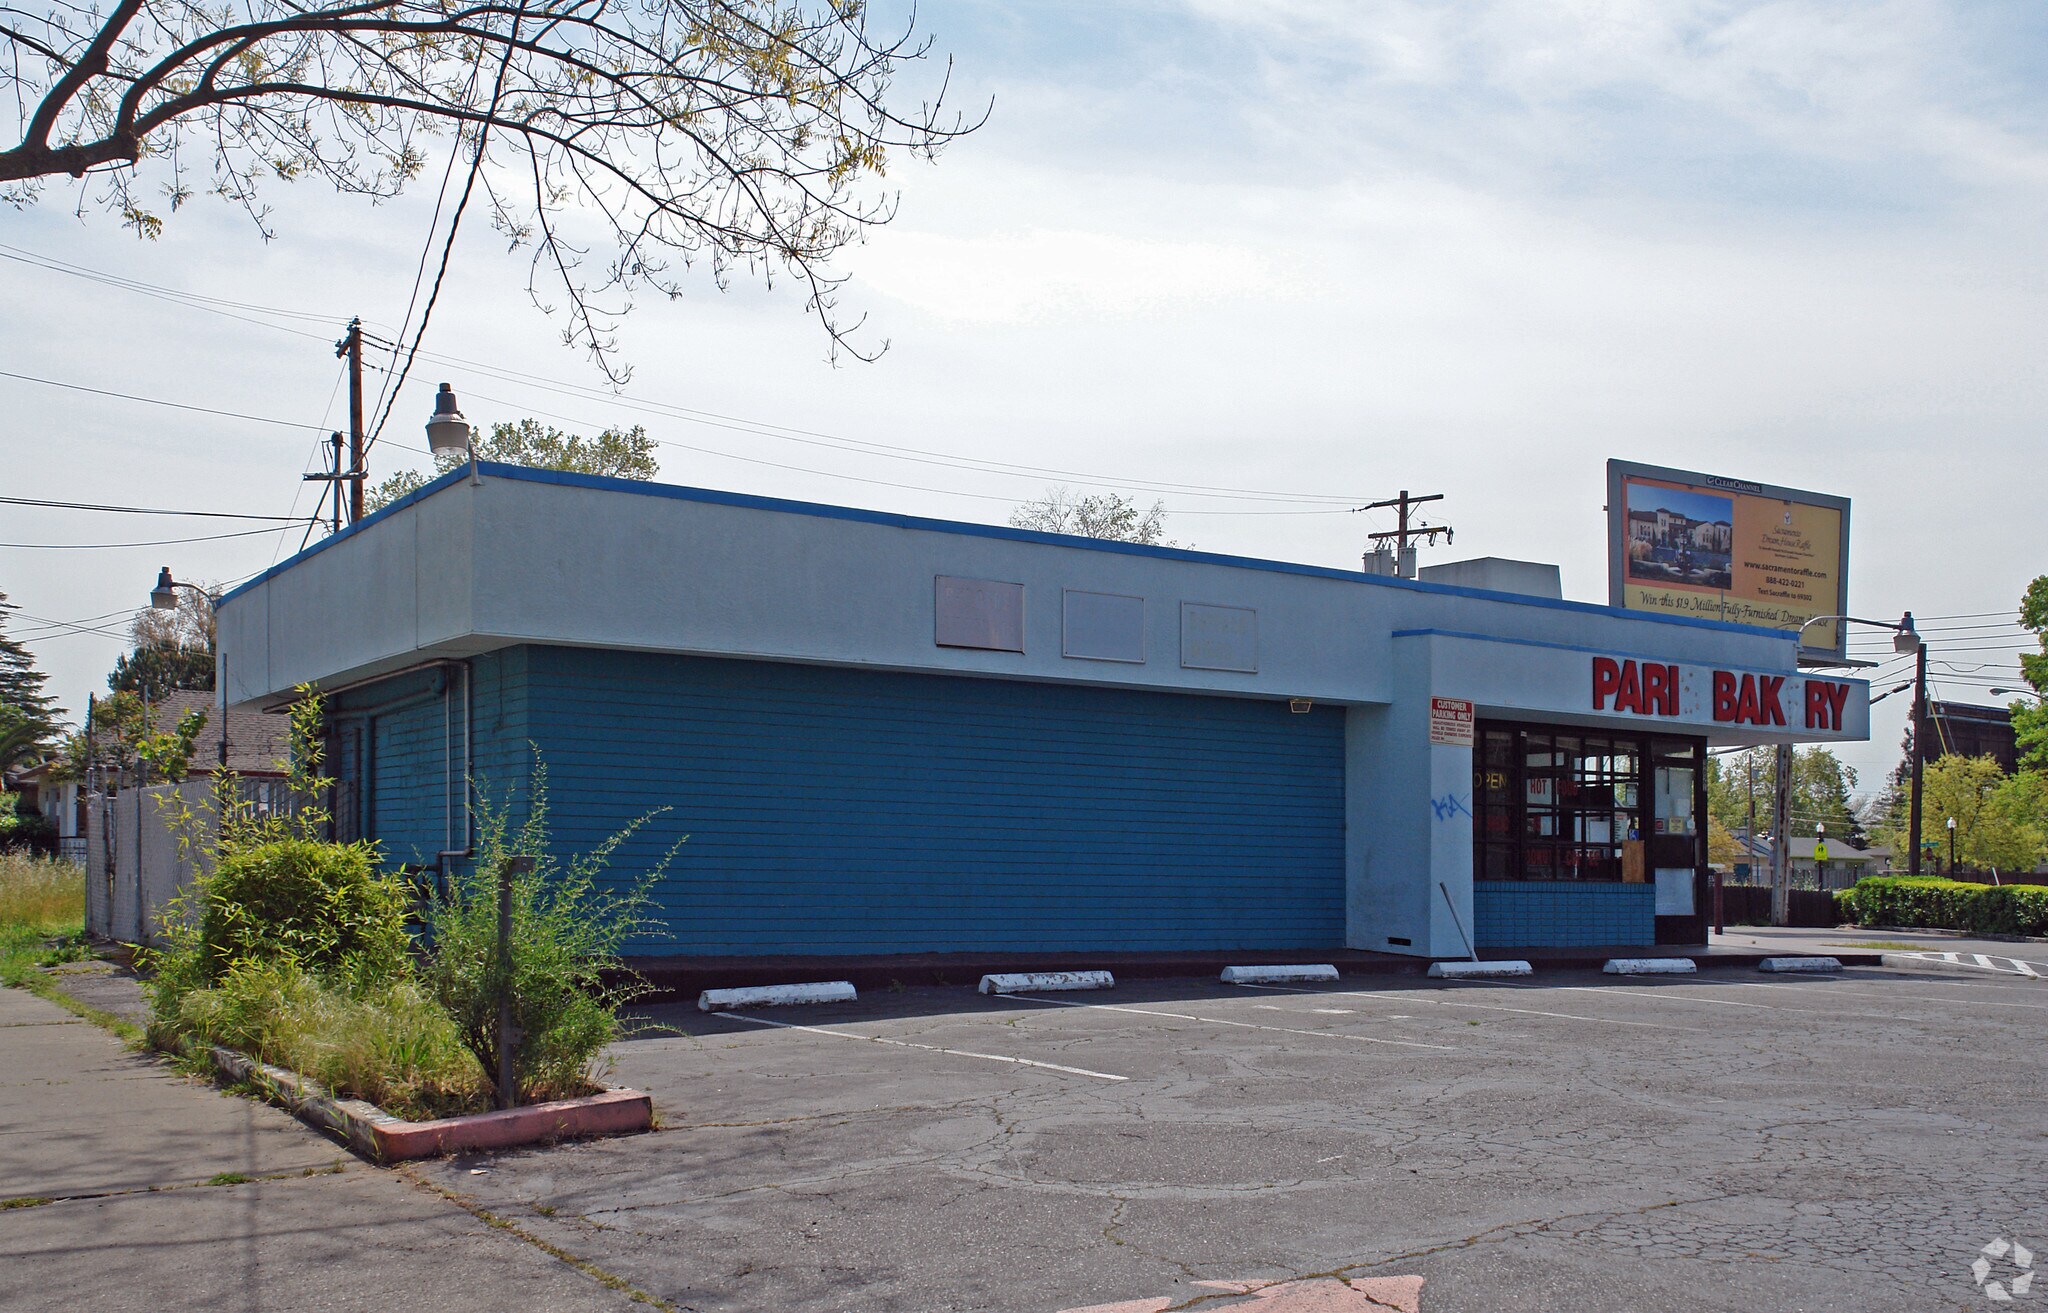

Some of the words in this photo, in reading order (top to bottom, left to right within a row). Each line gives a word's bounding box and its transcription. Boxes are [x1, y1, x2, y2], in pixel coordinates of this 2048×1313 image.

[1744, 561, 1827, 579] www.sacramentoraffle.com
[1766, 576, 1805, 588] 888-422-0221
[1640, 591, 1657, 605] Win
[1659, 593, 1674, 607] this
[1690, 597, 1722, 613] Million
[1781, 610, 1804, 624] Dream
[1593, 656, 1679, 716] PARI
[1437, 700, 1467, 711] CUSTOMER
[1432, 709, 1456, 720] PARKING
[1457, 711, 1471, 721] ONLY
[1474, 772, 1507, 789] OPEN
[1530, 777, 1547, 794] HOT
